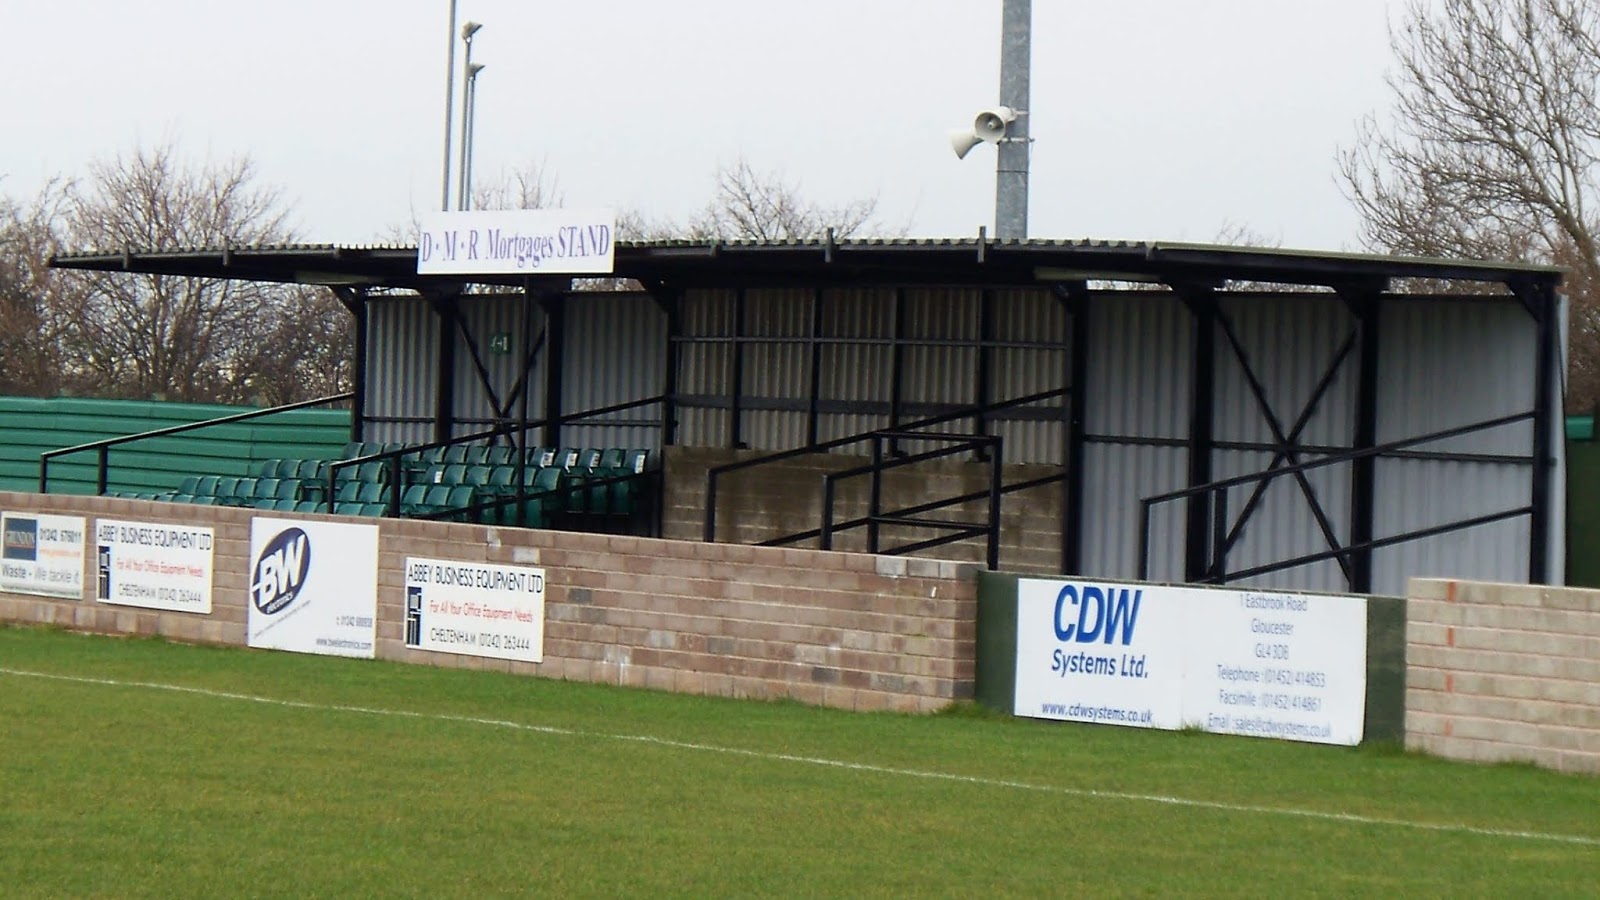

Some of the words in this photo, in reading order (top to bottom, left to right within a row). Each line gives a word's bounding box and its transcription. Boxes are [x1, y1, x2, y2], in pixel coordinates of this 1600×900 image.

[485, 229, 553, 268] Mortgages
[557, 225, 609, 258] STAND
[40, 528, 57, 541] 01242
[98, 525, 118, 543] ABBEY
[121, 526, 152, 546] BUSINESS
[154, 529, 197, 549] EQUIPMENT
[199, 533, 212, 551] LTD
[2, 564, 26, 579] Waste
[34, 566, 46, 581] We
[49, 568, 72, 583] tackle
[133, 559, 143, 572] Your
[144, 560, 159, 573] Office
[160, 561, 186, 576] Equipment
[187, 565, 203, 578] Needs
[258, 533, 306, 608] BW
[407, 564, 433, 583] ABBEY
[435, 565, 474, 588] BUSINESS
[476, 569, 526, 592] EQUIPMENT
[528, 574, 543, 593] LTD
[119, 583, 156, 598] CHELTENHAM
[430, 600, 439, 613] For
[440, 601, 448, 613] All
[450, 602, 461, 615] Your
[463, 602, 481, 617] Office
[483, 604, 513, 620] Equipment
[514, 609, 534, 623] Needs
[1246, 593, 1285, 610] Eastbrook
[1287, 595, 1308, 611] Road
[1054, 584, 1142, 646] CDW
[1252, 618, 1294, 635] Gloucester
[430, 627, 476, 645] CHELTENHAM
[479, 632, 501, 650] (01242)
[504, 635, 530, 650] 263444
[1255, 643, 1271, 658] GL4
[1052, 648, 1117, 678] Systems
[1121, 653, 1149, 679] Ltd.
[1217, 664, 1260, 683] Telephone
[1219, 689, 1256, 707] Facsimile
[1042, 703, 1153, 723] www.cdwsystems.co.uk
[1209, 713, 1230, 729] Email
